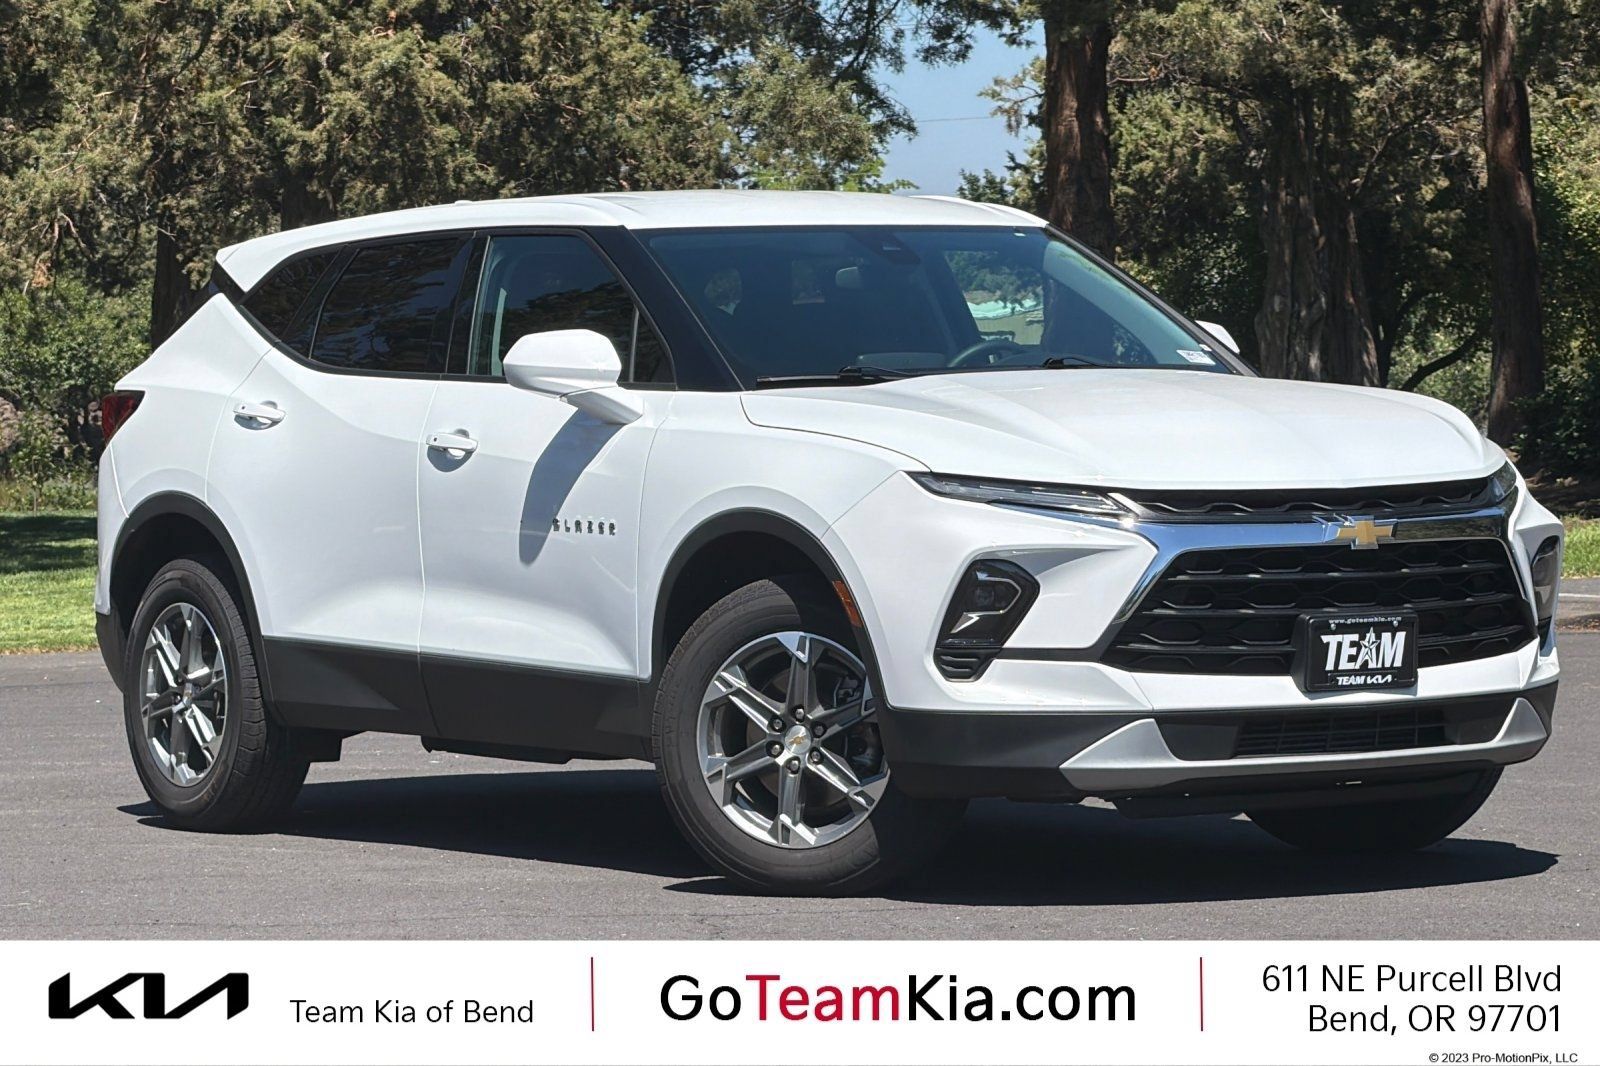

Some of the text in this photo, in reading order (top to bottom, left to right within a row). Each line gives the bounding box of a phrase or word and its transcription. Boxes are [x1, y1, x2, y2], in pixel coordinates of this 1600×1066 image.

[552, 518, 616, 536] BLAZER
[1328, 616, 1402, 625] www.goteamkia.com
[1320, 629, 1406, 671] TEAM
[1336, 675, 1393, 686] TEAM KIA
